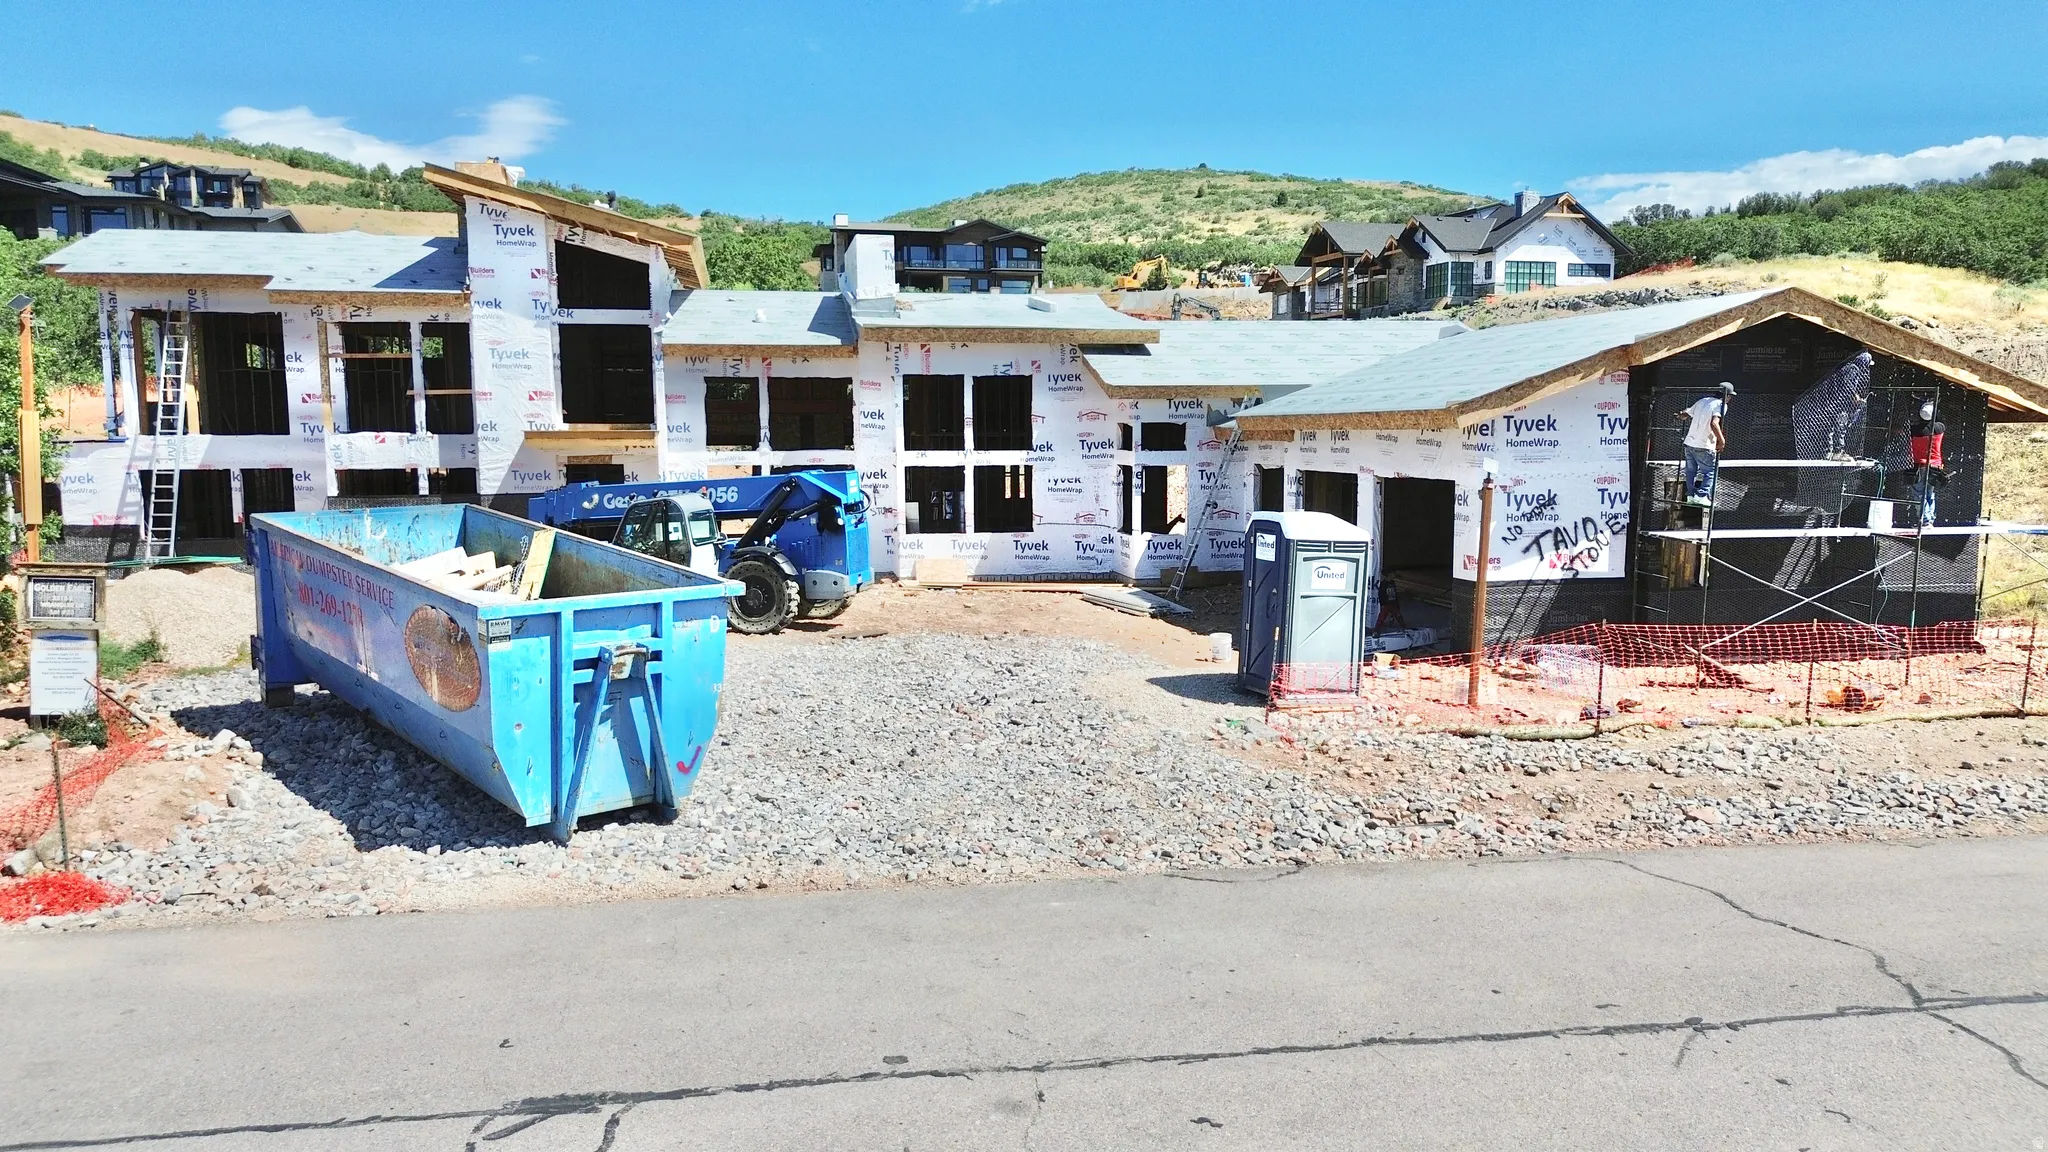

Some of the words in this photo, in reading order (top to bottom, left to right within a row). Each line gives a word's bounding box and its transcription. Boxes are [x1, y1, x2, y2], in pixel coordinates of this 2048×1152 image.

[493, 224, 535, 238] Tyvek
[496, 239, 537, 248] HomeWrap
[489, 347, 530, 360] Tyvek
[491, 362, 533, 371] HomeWrap
[859, 379, 882, 387] Builders
[1167, 398, 1204, 412] Tyvek
[667, 422, 691, 433] vek
[1503, 414, 1558, 437] Tyvek
[1375, 432, 1399, 444] HomeWrap
[1415, 437, 1442, 448] HomeWrap
[1506, 438, 1560, 449] HomeWrap
[1079, 438, 1115, 453] Tyvek
[511, 469, 552, 483] Tyvek
[1047, 486, 1084, 494] HomeWrap
[1506, 489, 1558, 512] Tyvek
[1506, 513, 1560, 522] HomeWrap
[1501, 525, 1523, 545] NO
[951, 539, 987, 552] Tyvek
[1013, 539, 1049, 553] Tyvek
[1147, 539, 1182, 553] Tyvek
[1209, 538, 1245, 552] Tyvek
[1560, 514, 1626, 578] STONE
[952, 553, 989, 561] HomeWrap
[1014, 553, 1051, 561] HomeWrap
[1147, 553, 1184, 561] HomeWrap
[1316, 569, 1345, 580] United
[305, 555, 355, 590] DUMPSTER
[355, 575, 395, 610] SERVICE
[711, 615, 721, 633] D
